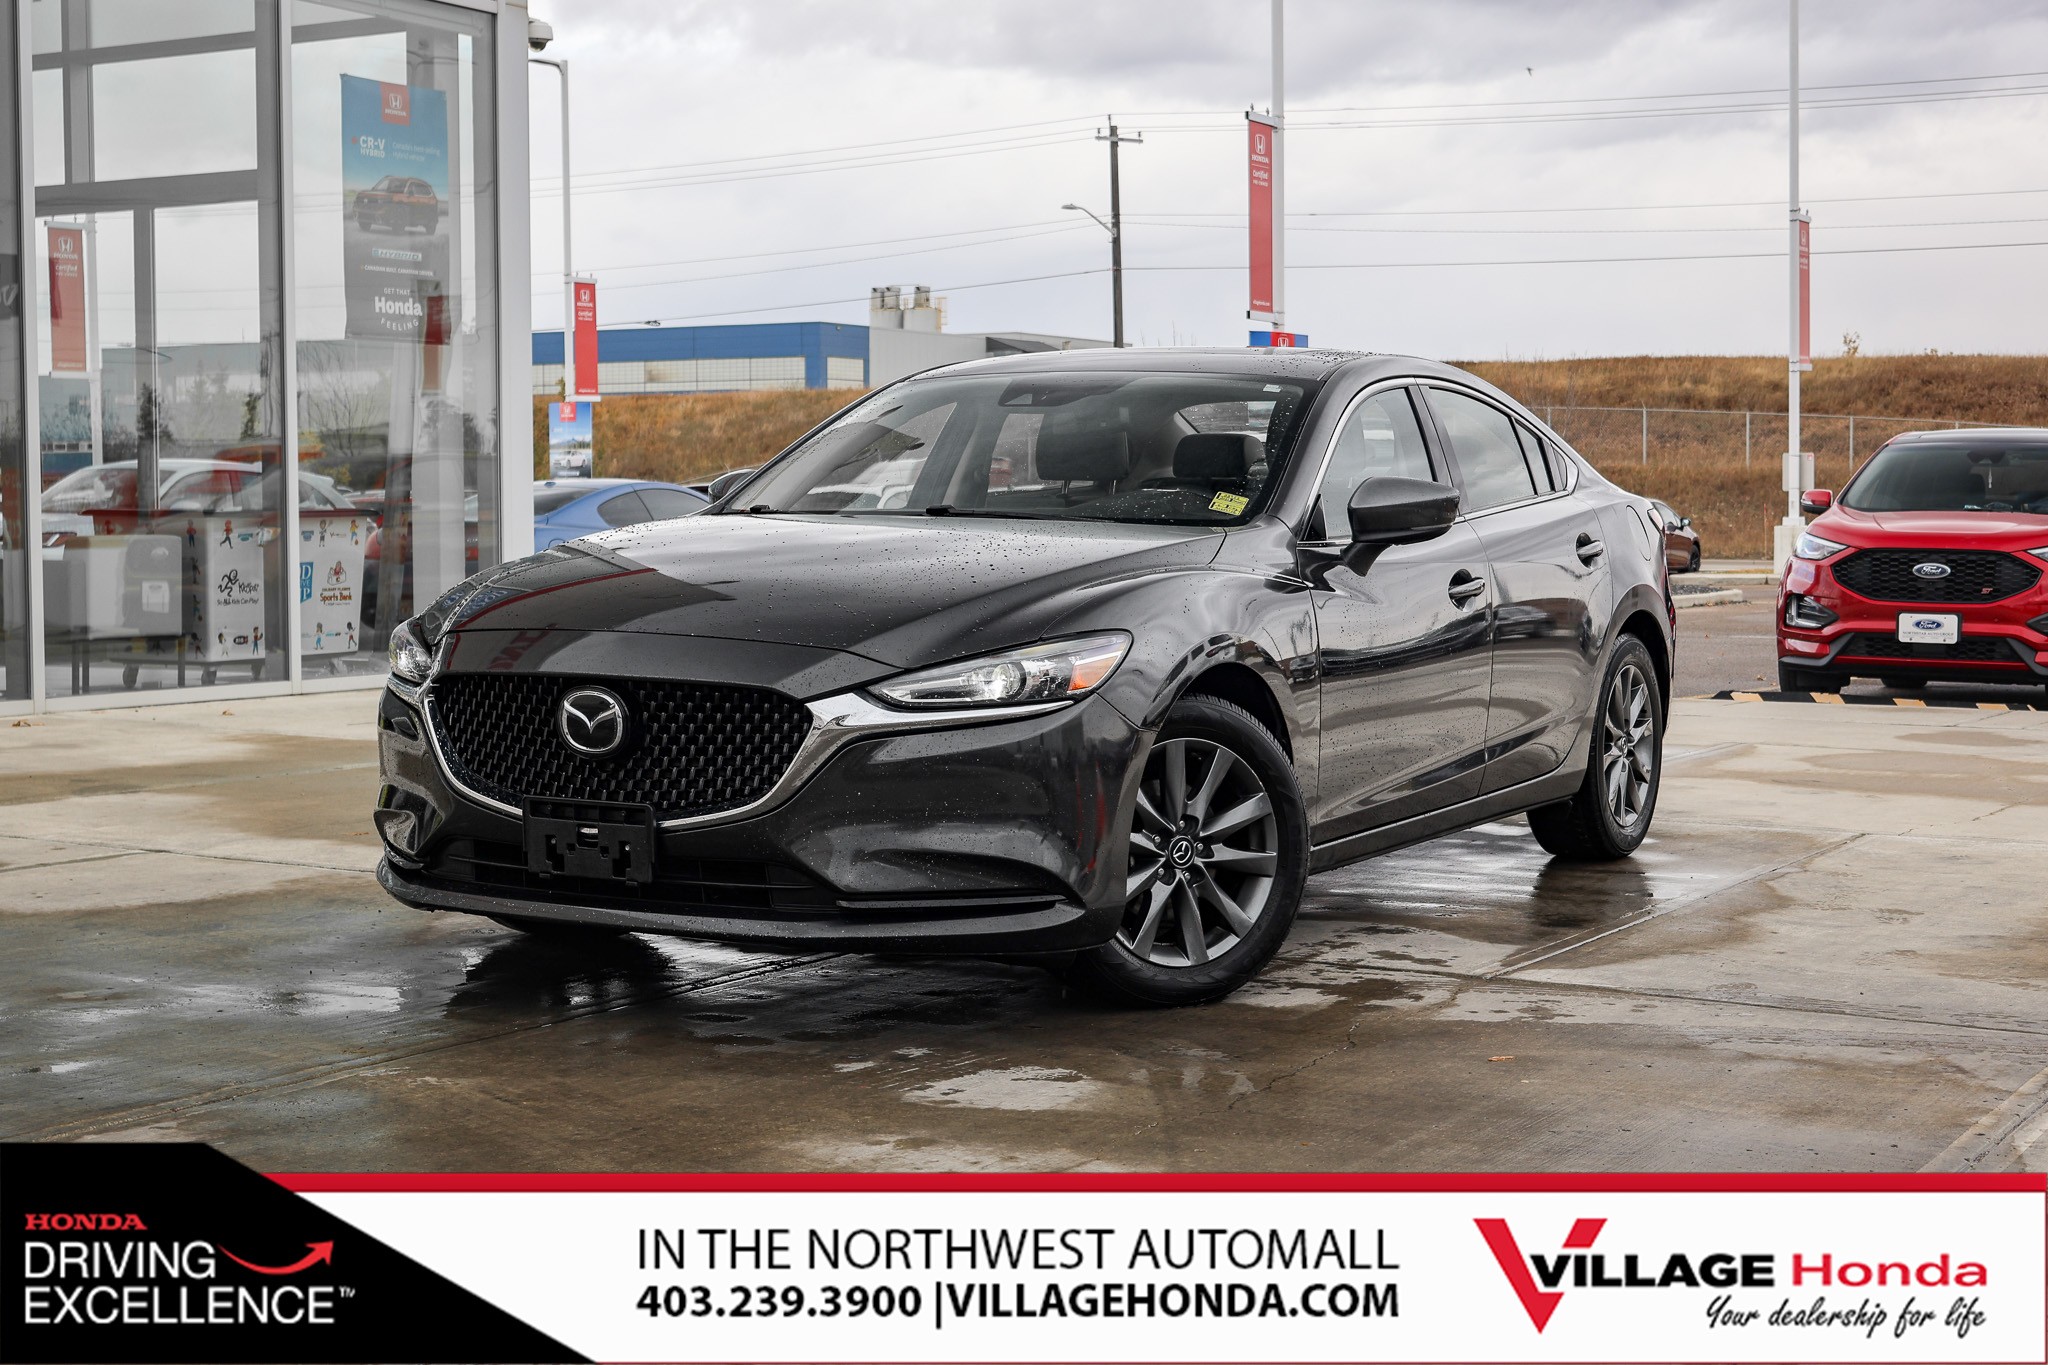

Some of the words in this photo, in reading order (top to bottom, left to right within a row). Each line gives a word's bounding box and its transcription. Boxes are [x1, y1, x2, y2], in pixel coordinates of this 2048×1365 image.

[360, 136, 385, 150] CR-V
[361, 148, 385, 158] HYBRID
[1251, 154, 1269, 163] HONDA
[375, 296, 422, 316] Honda
[380, 317, 419, 331] FEELING
[1920, 566, 1942, 574] Ford
[1919, 620, 1937, 629] Ford
